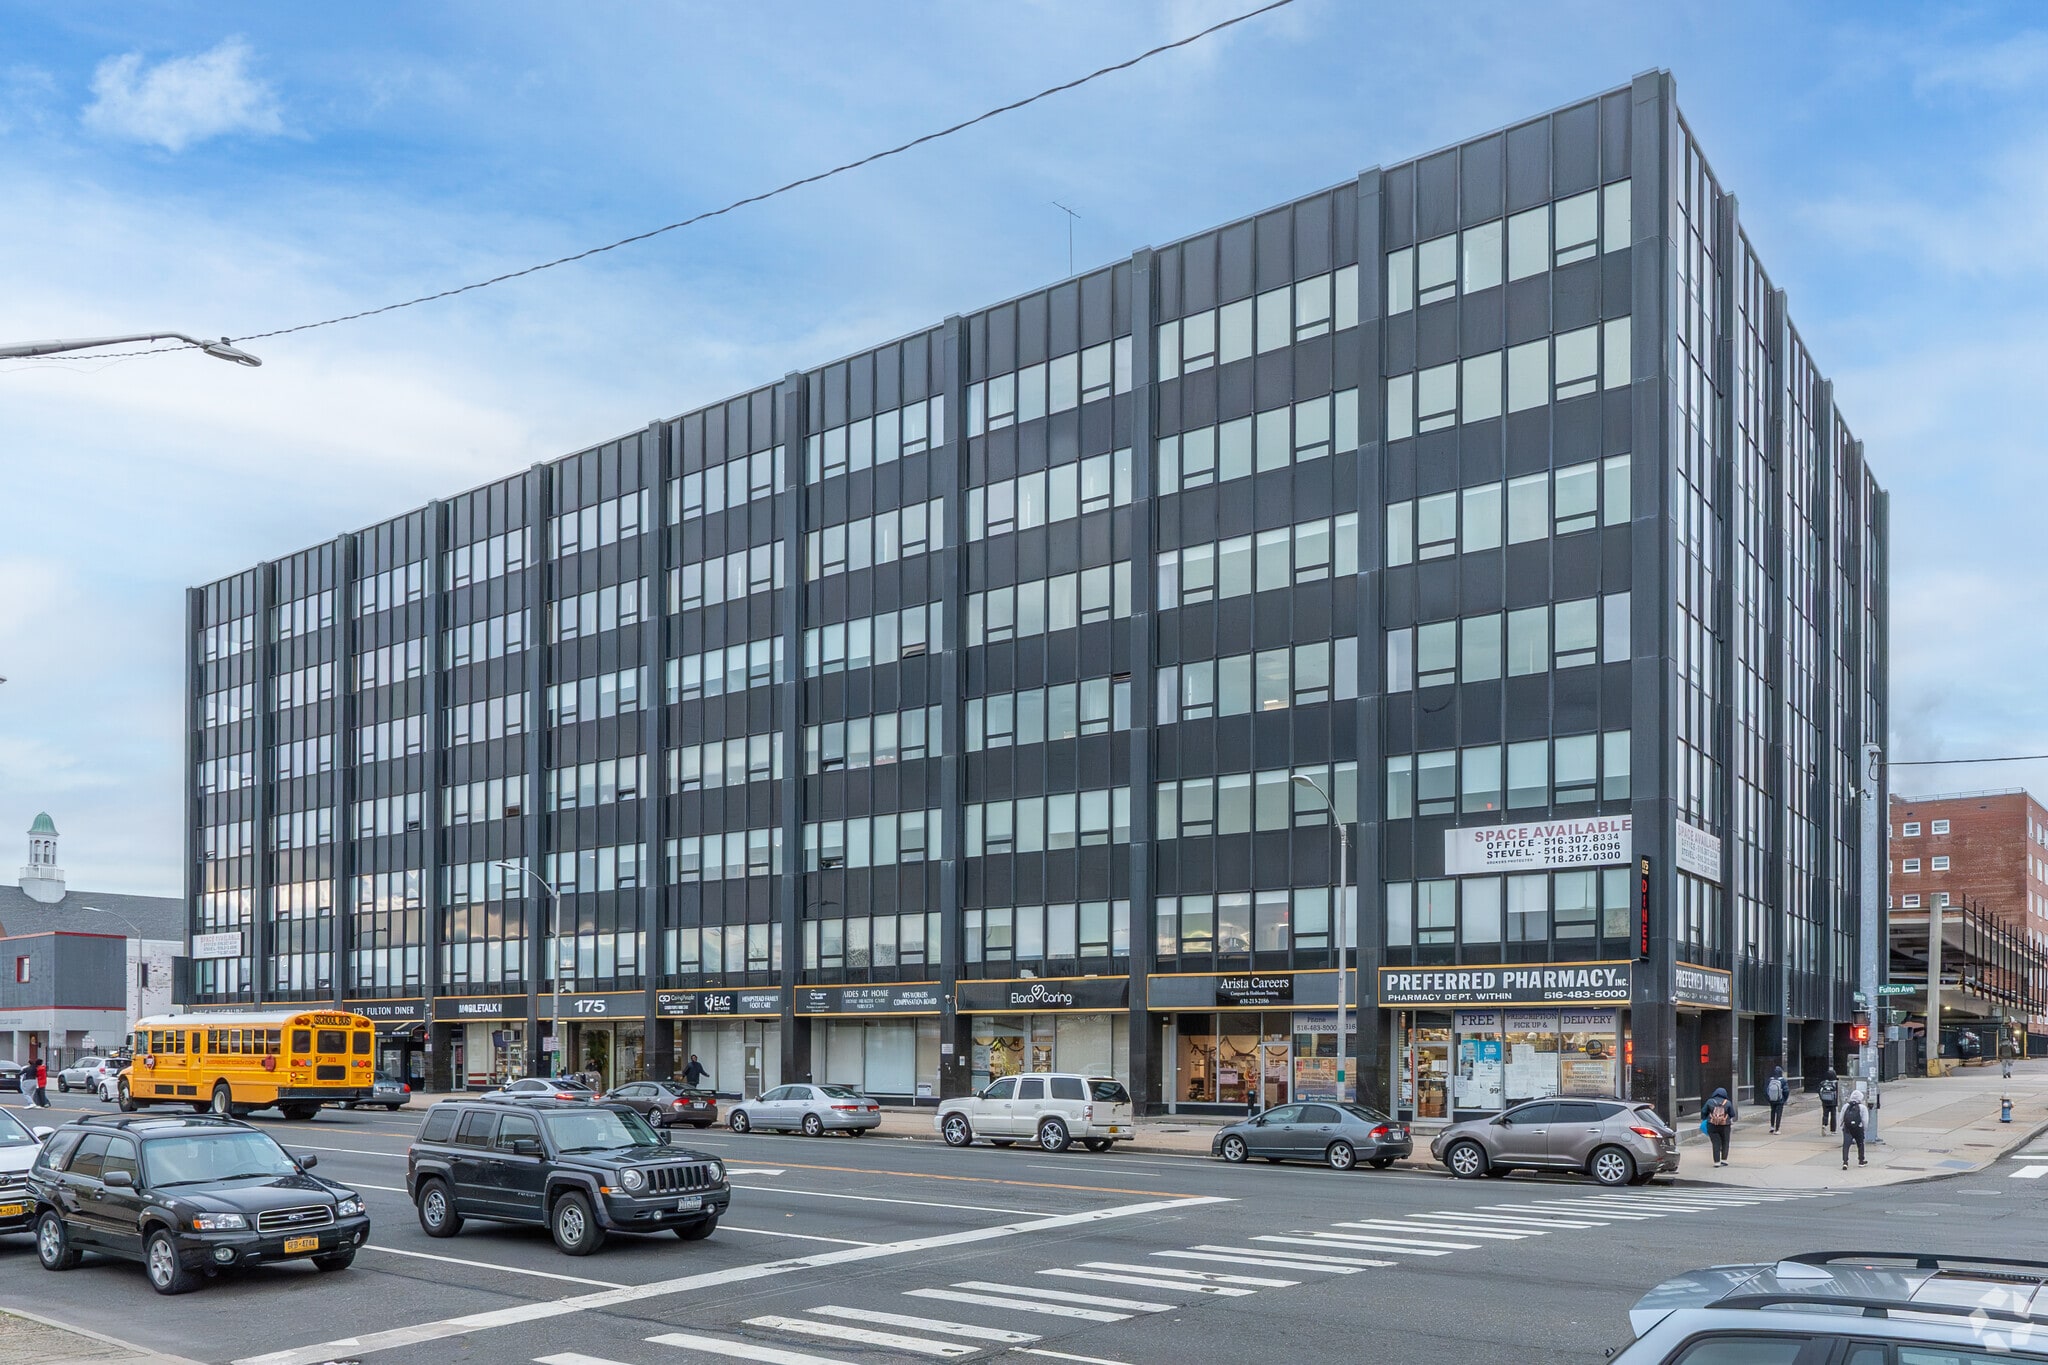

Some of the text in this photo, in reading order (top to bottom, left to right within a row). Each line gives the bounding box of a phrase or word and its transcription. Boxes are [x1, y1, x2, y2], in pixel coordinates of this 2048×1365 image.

[1474, 820, 1631, 842] SPACE AVAILABLE
[1486, 839, 1535, 850] OFFICE
[1544, 832, 1619, 846] 516.307.8334
[1486, 849, 1522, 859] STEVE
[1525, 848, 1535, 856] L.
[1544, 842, 1621, 854] 516.312.6096
[1544, 852, 1621, 864] 718.267.0300
[1221, 978, 1289, 989] Arista Careers
[1386, 972, 1496, 991] PREFERRED
[1503, 969, 1616, 988] PHARMACY
[1676, 969, 1702, 990] PREFERRED
[1011, 992, 1072, 1005] Elara Caring
[1544, 990, 1627, 999] 516-483-5000
[574, 1000, 606, 1013] 175
[714, 996, 730, 1006] EAC
[354, 1006, 414, 1016] 175 FULTON DINER
[459, 1004, 498, 1013] MOBILETALK
[1462, 1015, 1494, 1025] FREE
[1564, 1016, 1612, 1024] DELIVERY
